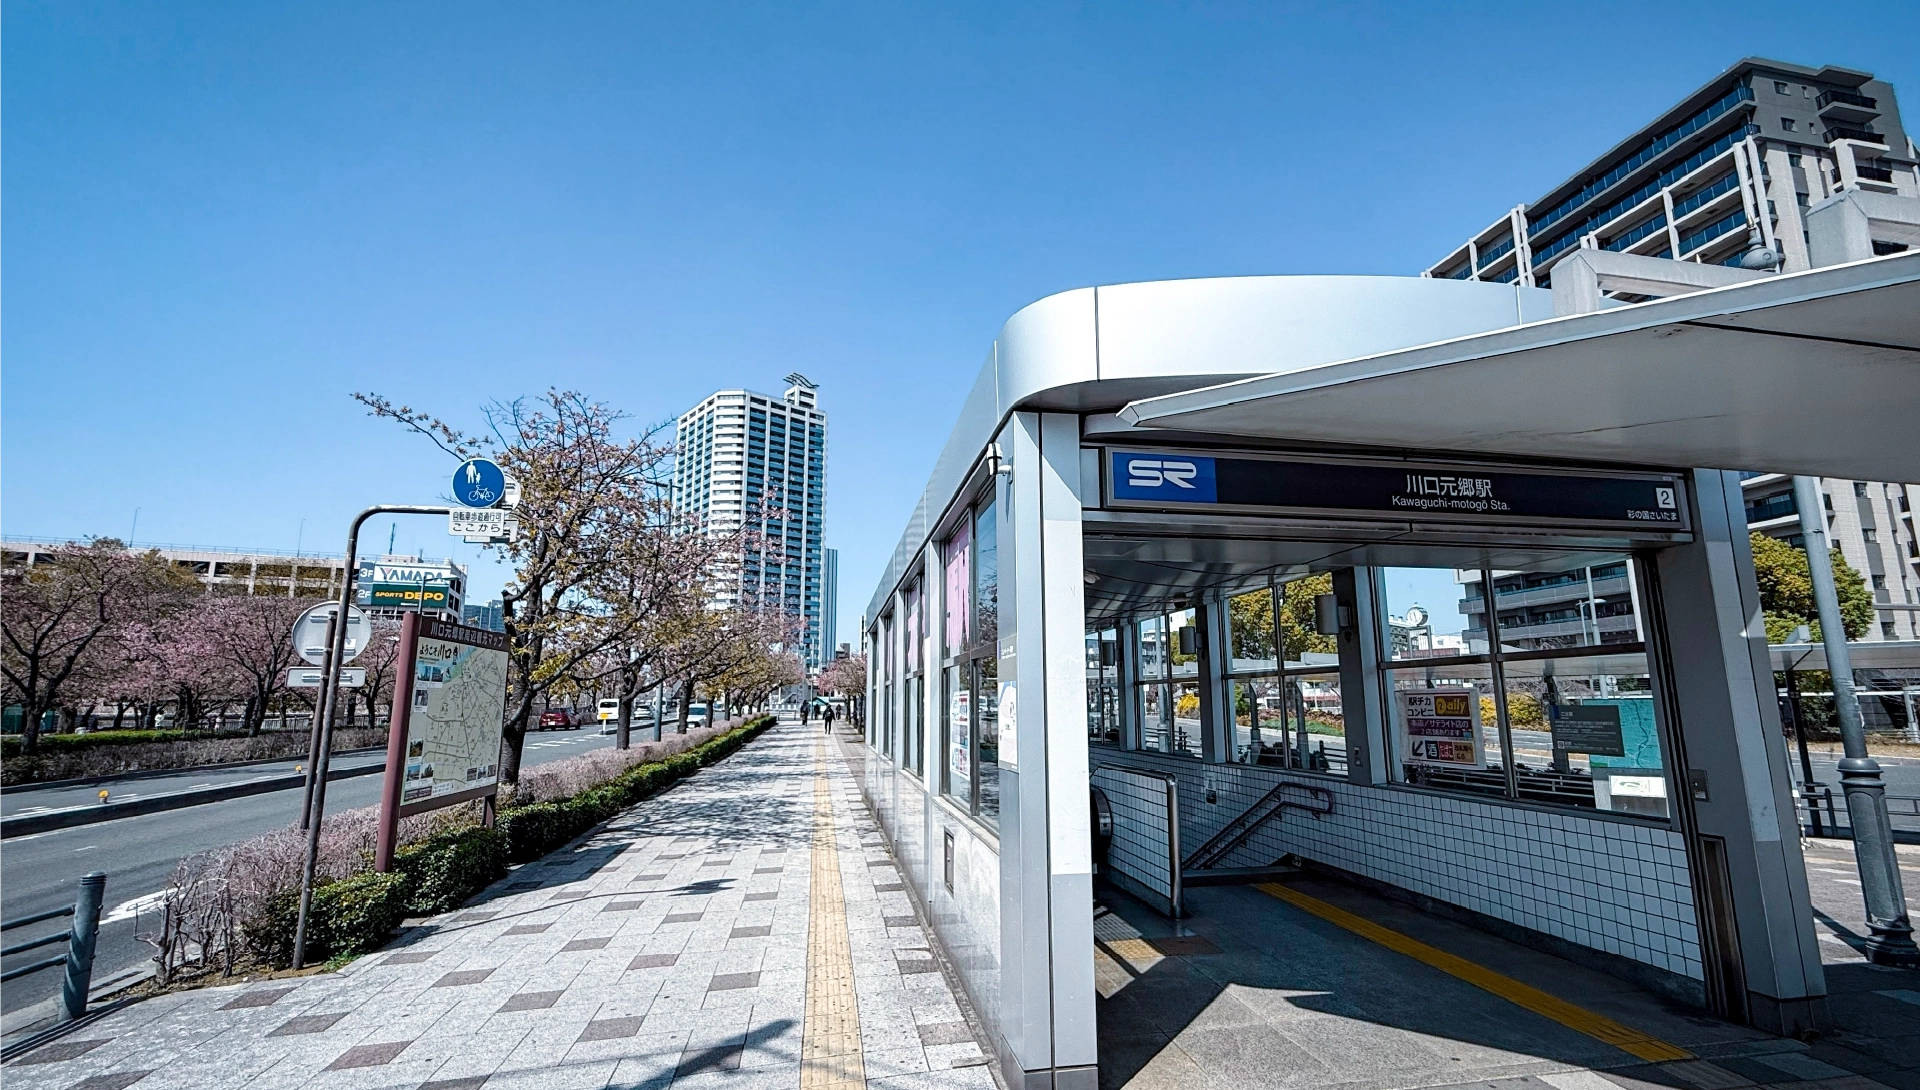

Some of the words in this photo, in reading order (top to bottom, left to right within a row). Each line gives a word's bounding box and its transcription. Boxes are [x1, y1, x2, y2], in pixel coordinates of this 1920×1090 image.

[1128, 459, 1197, 489] SR
[1406, 474, 1493, 498] 川口元郷駅
[1660, 490, 1671, 505] 2
[1490, 499, 1511, 510] Sta.
[1627, 509, 1677, 521] 彩の国さいたま
[453, 523, 501, 533] ここから
[360, 568, 374, 578] 3F
[379, 567, 445, 582] YAMADA
[357, 589, 372, 598] 2F
[404, 591, 445, 601] DEPO
[1408, 696, 1432, 706] 駅チカ
[1435, 697, 1467, 715] Daily
[1407, 708, 1434, 717] コンビニ
[1427, 743, 1438, 757] 酒
